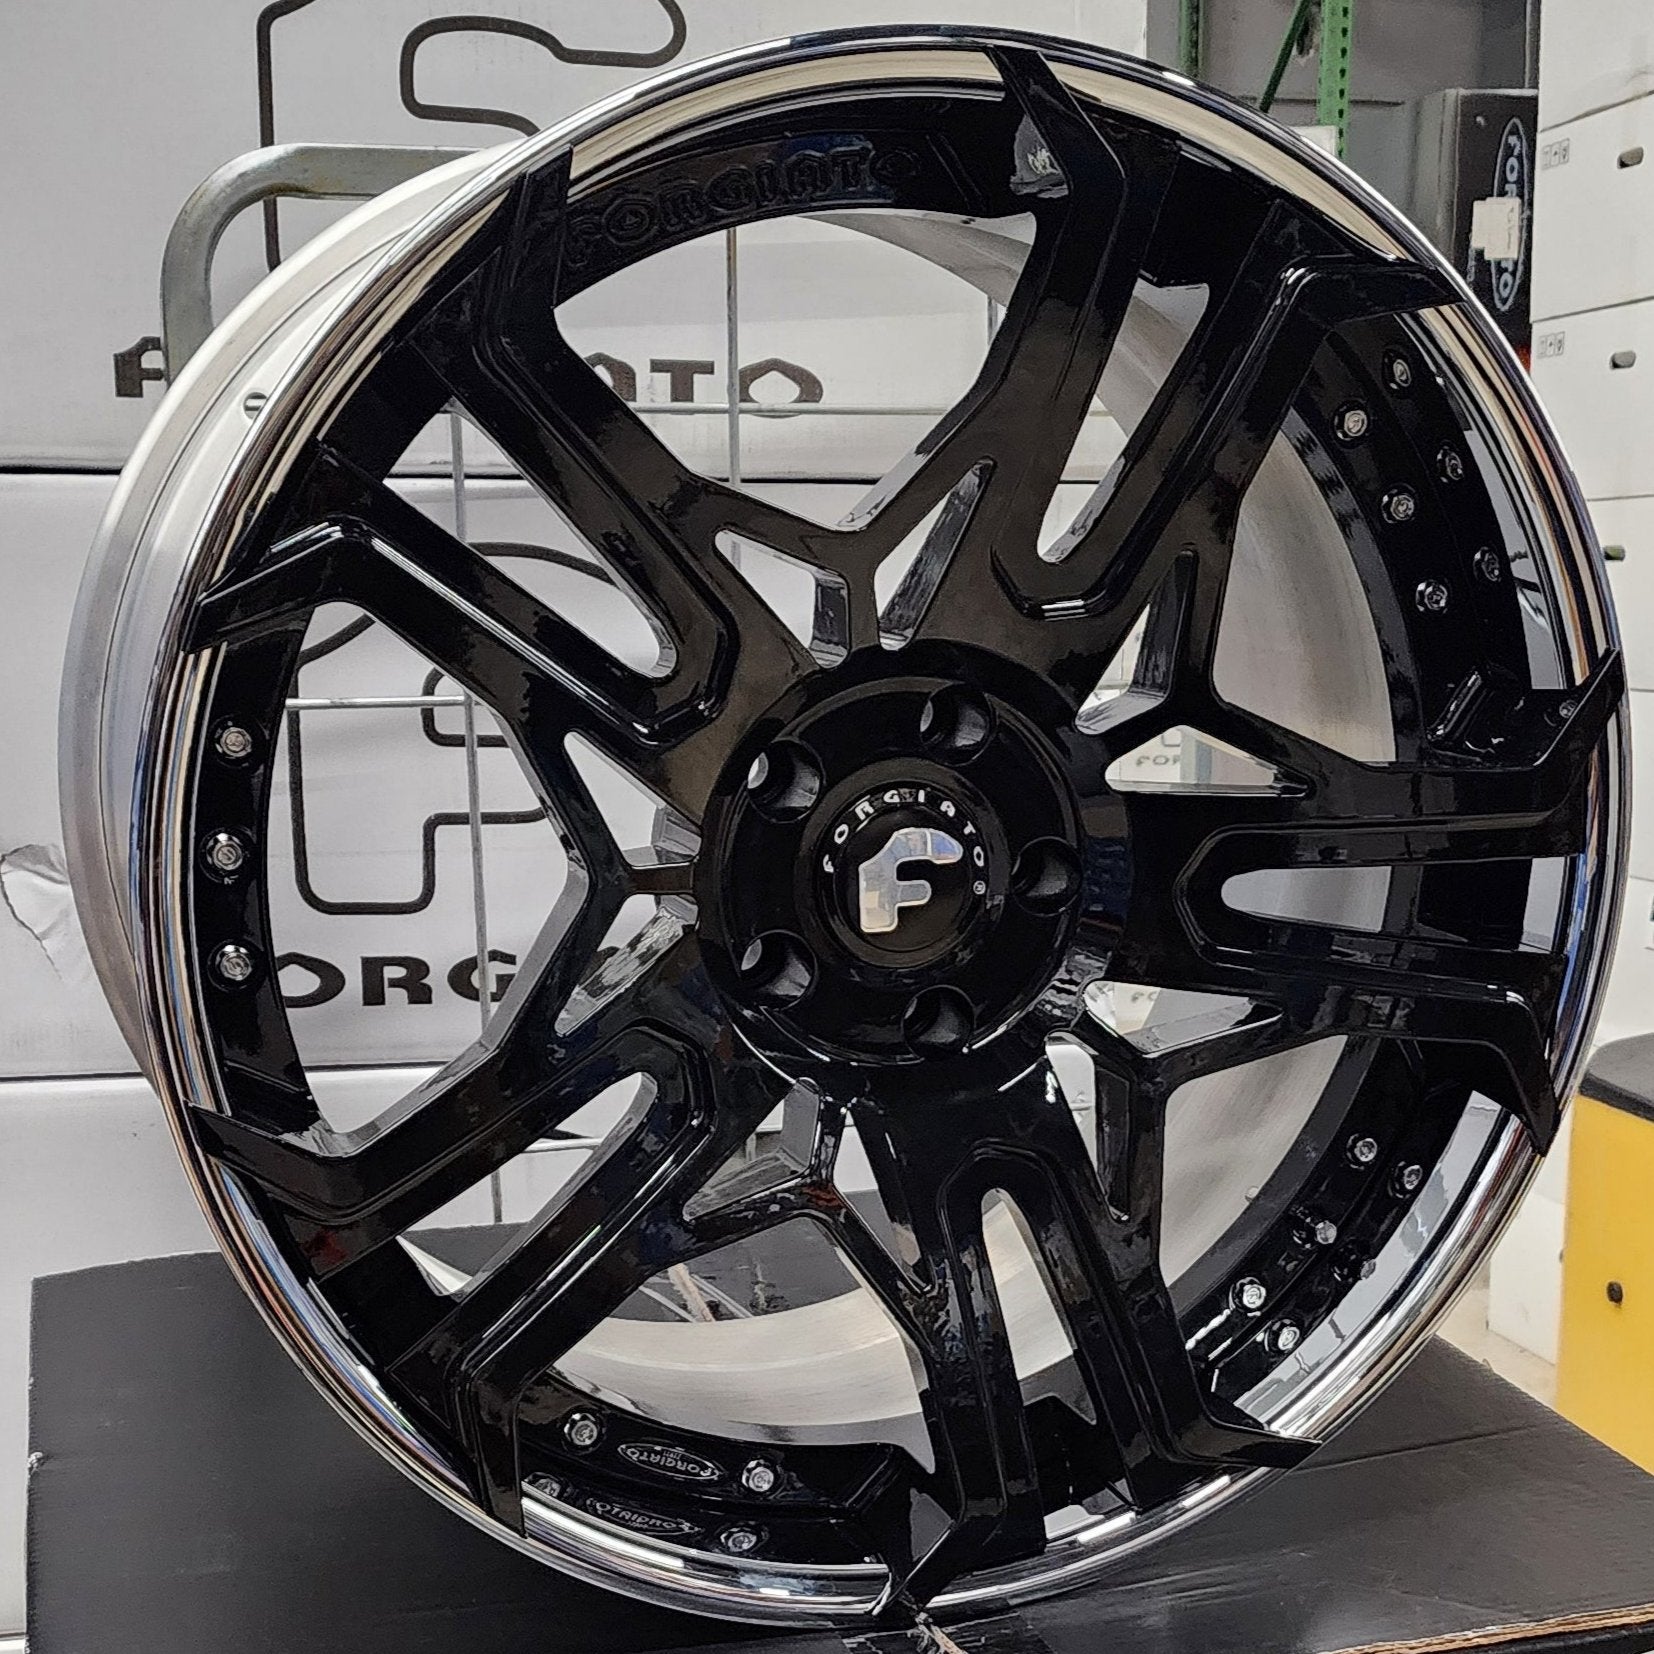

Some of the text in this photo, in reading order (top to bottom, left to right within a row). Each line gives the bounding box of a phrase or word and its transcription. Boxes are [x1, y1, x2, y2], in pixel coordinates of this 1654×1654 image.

[1499, 134, 1522, 298] FORTO
[822, 787, 985, 874] FORGIATO
[626, 1447, 713, 1477] FORGIATO
